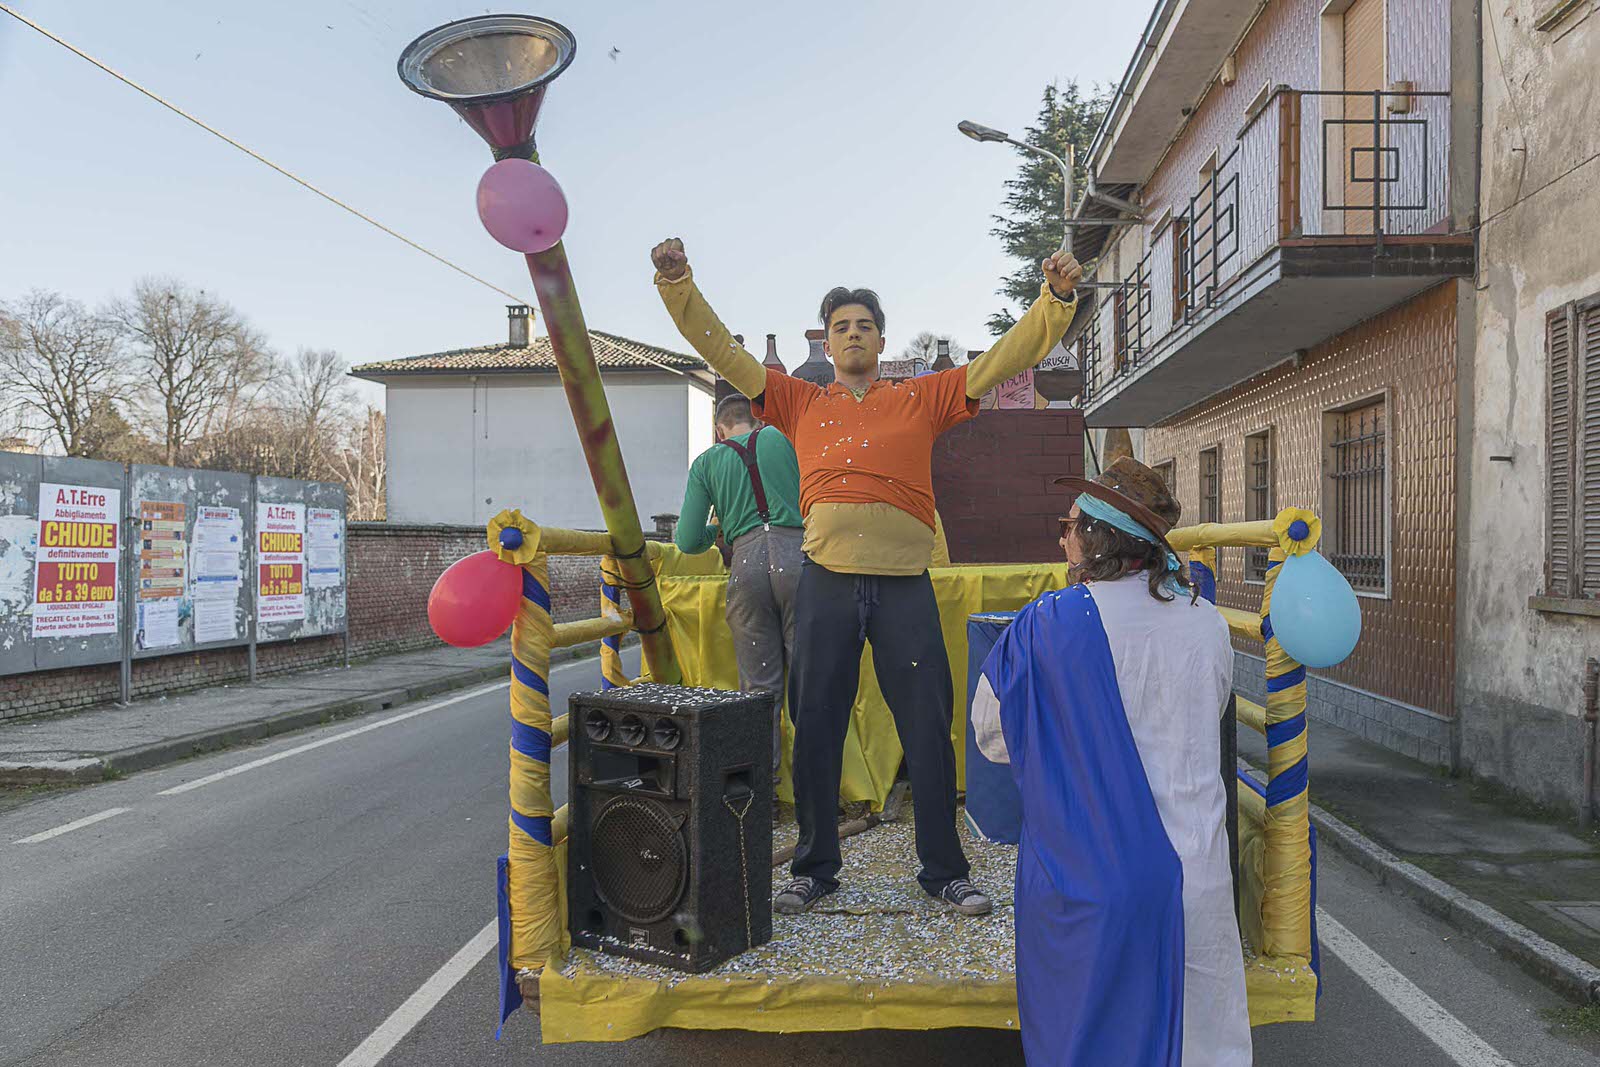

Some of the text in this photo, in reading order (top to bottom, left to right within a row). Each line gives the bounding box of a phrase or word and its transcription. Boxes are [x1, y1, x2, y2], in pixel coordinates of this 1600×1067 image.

[1042, 356, 1070, 368] BRUSCH
[56, 488, 106, 507] A.T.Erre
[55, 509, 107, 520] Abbigliamento
[267, 506, 296, 520] A.T.Erre
[45, 521, 113, 547] CHIUDE
[261, 532, 302, 552] CHIUDE
[48, 549, 110, 559] definitivamente
[57, 562, 99, 581] TUTTO
[269, 564, 293, 579] TUTTO
[39, 582, 114, 602] da 5 a 39 euro
[36, 615, 64, 624] TRECATE
[35, 624, 57, 632] Aperto
[58, 622, 76, 630] anche
